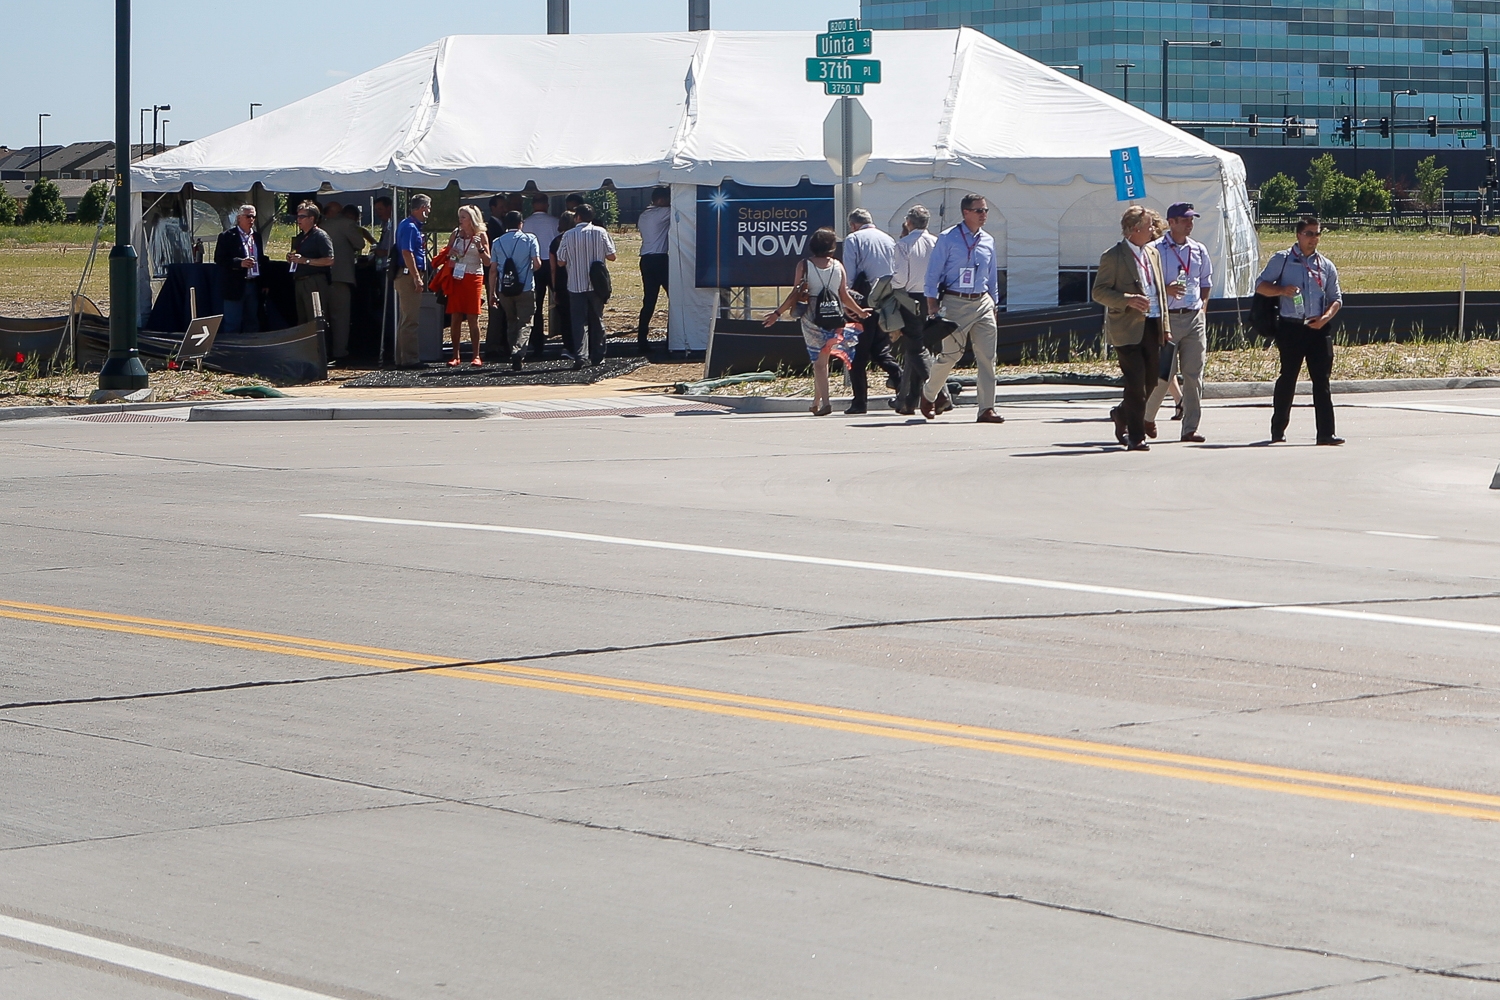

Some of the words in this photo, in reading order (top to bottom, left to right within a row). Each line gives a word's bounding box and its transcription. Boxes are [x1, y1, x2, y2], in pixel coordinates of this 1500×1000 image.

[830, 21, 847, 32] 8200
[849, 20, 854, 30] E
[821, 35, 855, 55] Uinta
[862, 37, 870, 48] St
[819, 61, 852, 79] 37th
[863, 66, 872, 76] Pl
[831, 84, 851, 94] 3750
[854, 84, 860, 94] N
[1121, 150, 1135, 197] BLUE
[738, 206, 808, 221] Stapleton
[738, 221, 808, 233] BUSINESS
[737, 234, 808, 256] NOW
